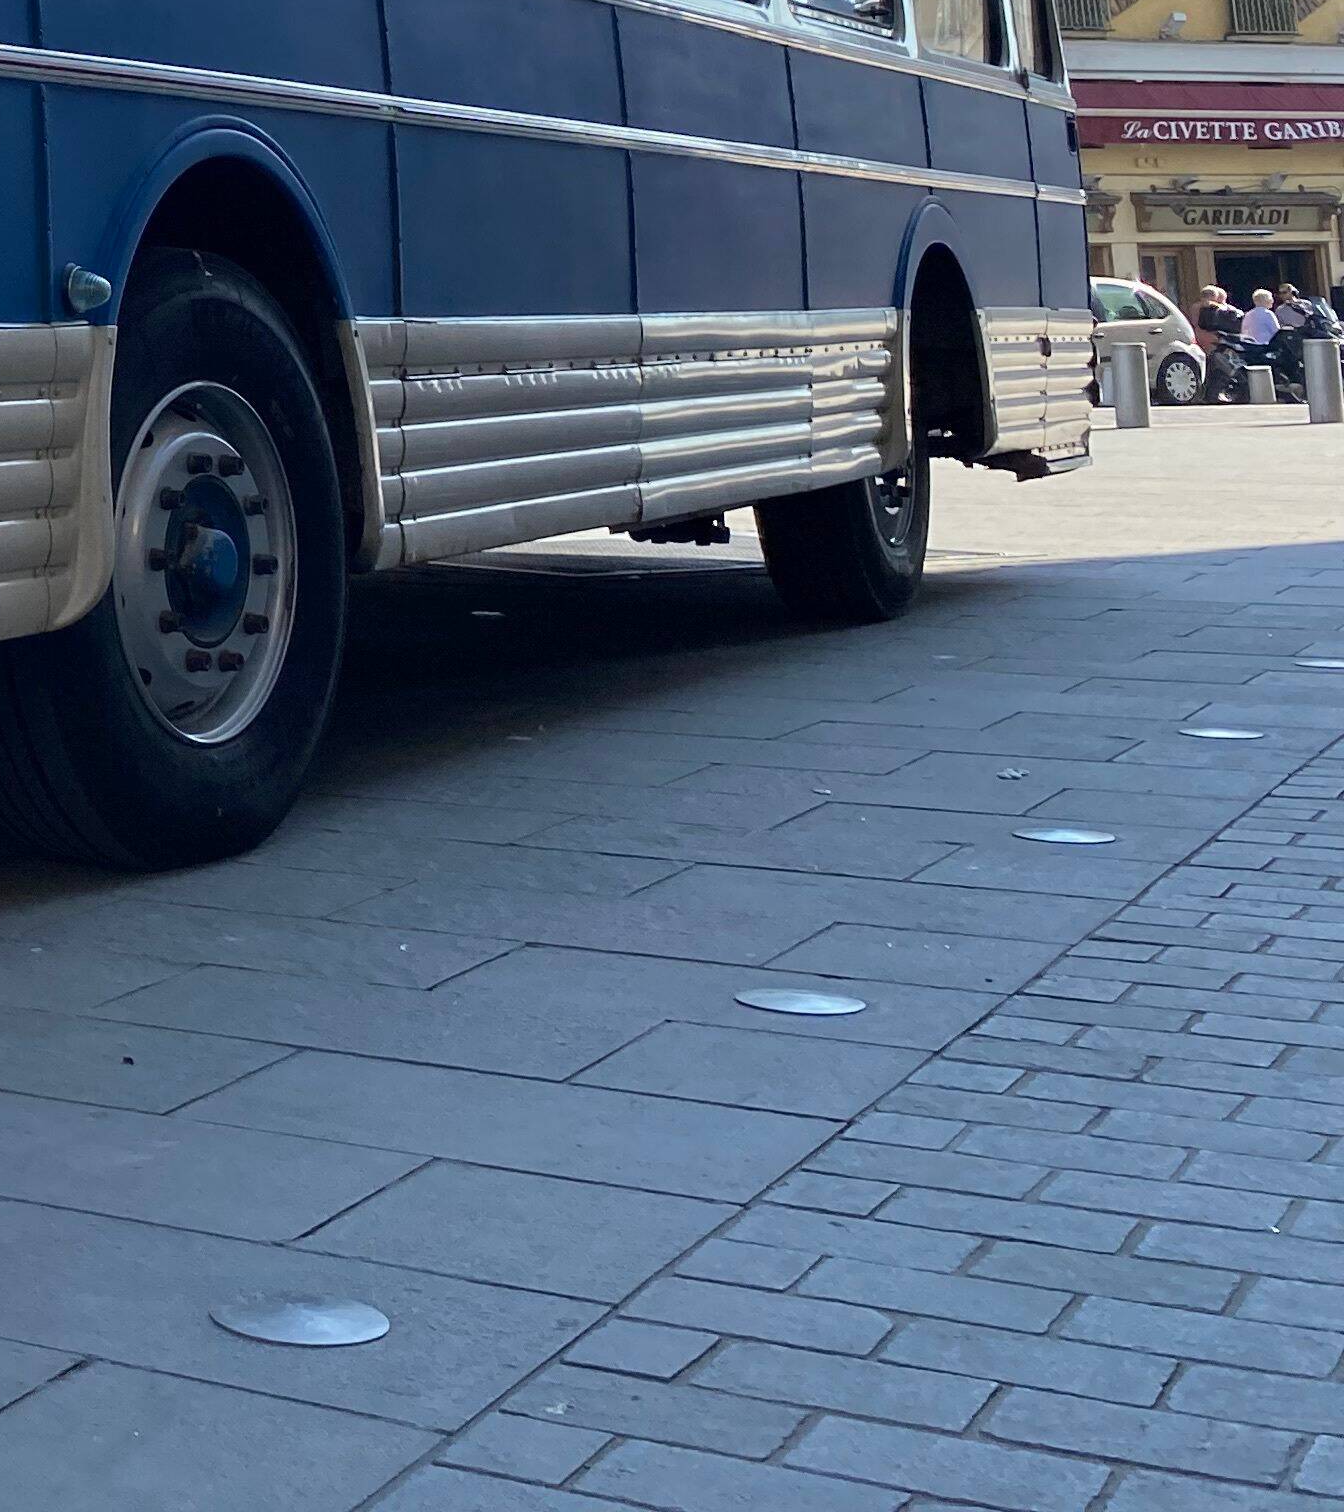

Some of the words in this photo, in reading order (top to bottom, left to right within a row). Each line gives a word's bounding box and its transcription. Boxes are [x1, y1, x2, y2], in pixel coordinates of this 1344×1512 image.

[1121, 120, 1152, 139] La
[1152, 120, 1258, 140] CIVETTE
[1264, 119, 1344, 141] GARIB
[1183, 208, 1291, 227] GARIBALDI
